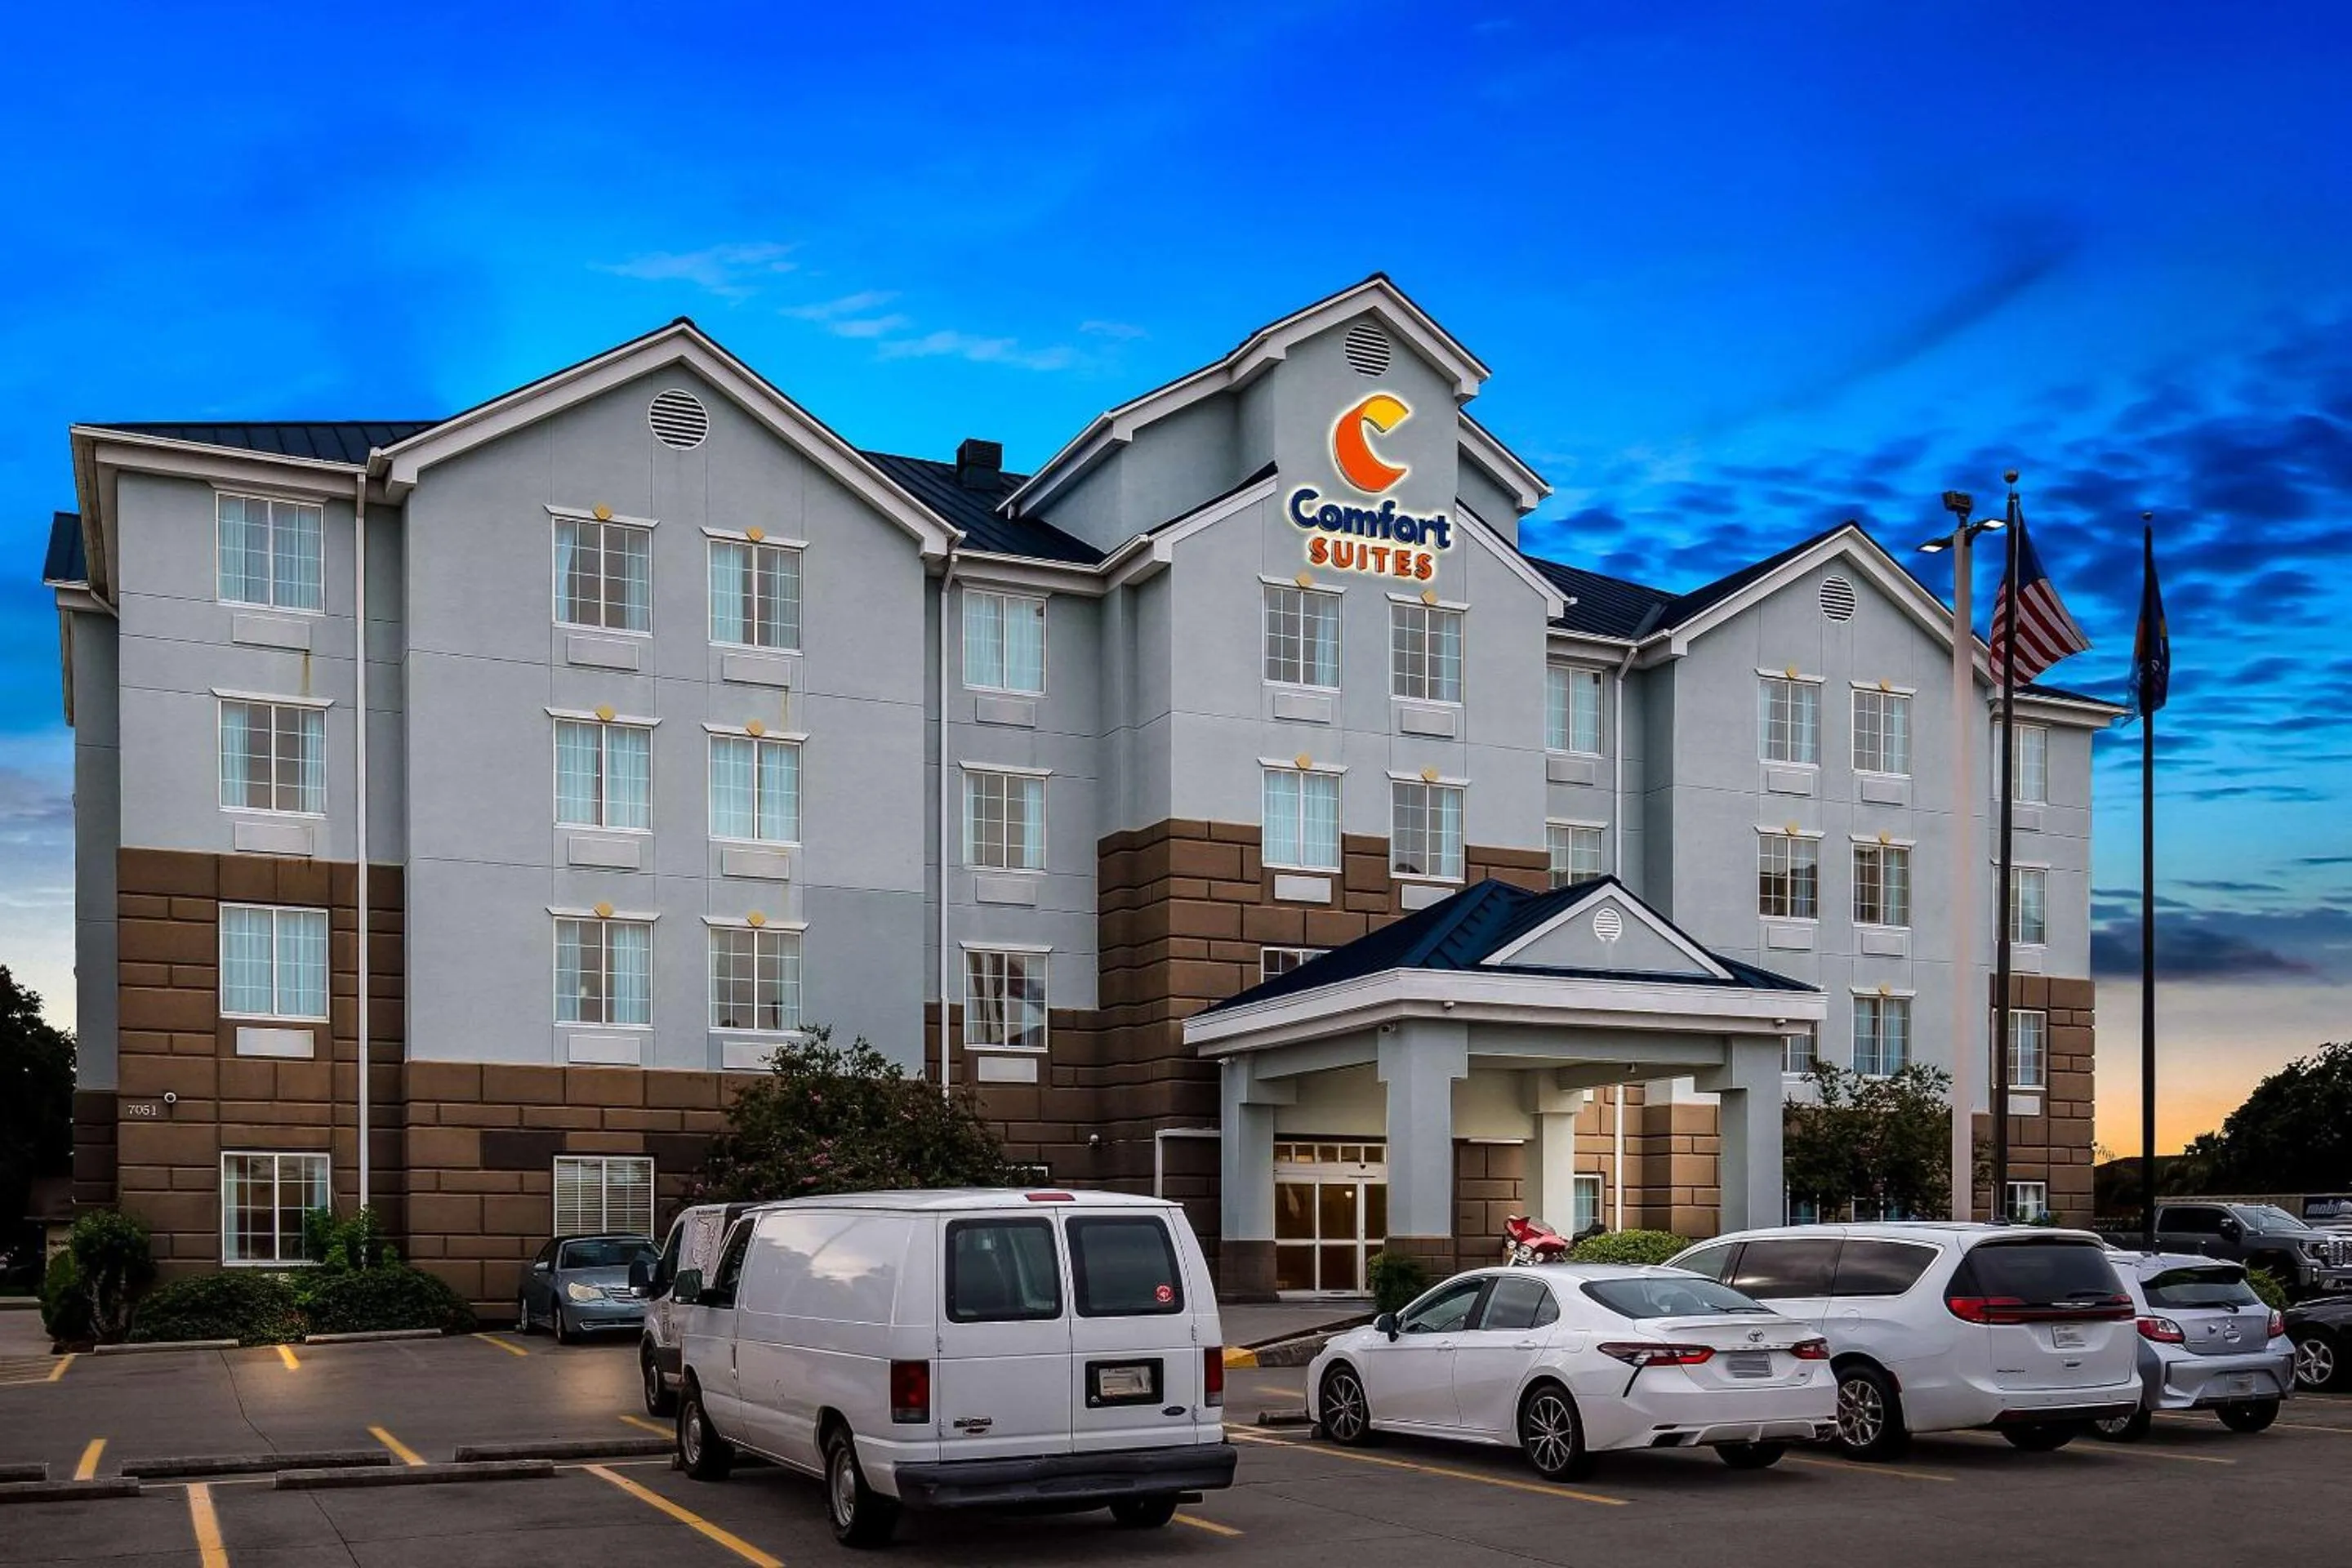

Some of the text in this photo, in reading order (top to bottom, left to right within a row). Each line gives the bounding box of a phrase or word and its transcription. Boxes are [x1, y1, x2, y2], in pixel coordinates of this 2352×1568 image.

[1290, 488, 1450, 549] Comfort
[1308, 537, 1433, 580] SUITES
[127, 1104, 157, 1116] 7051
